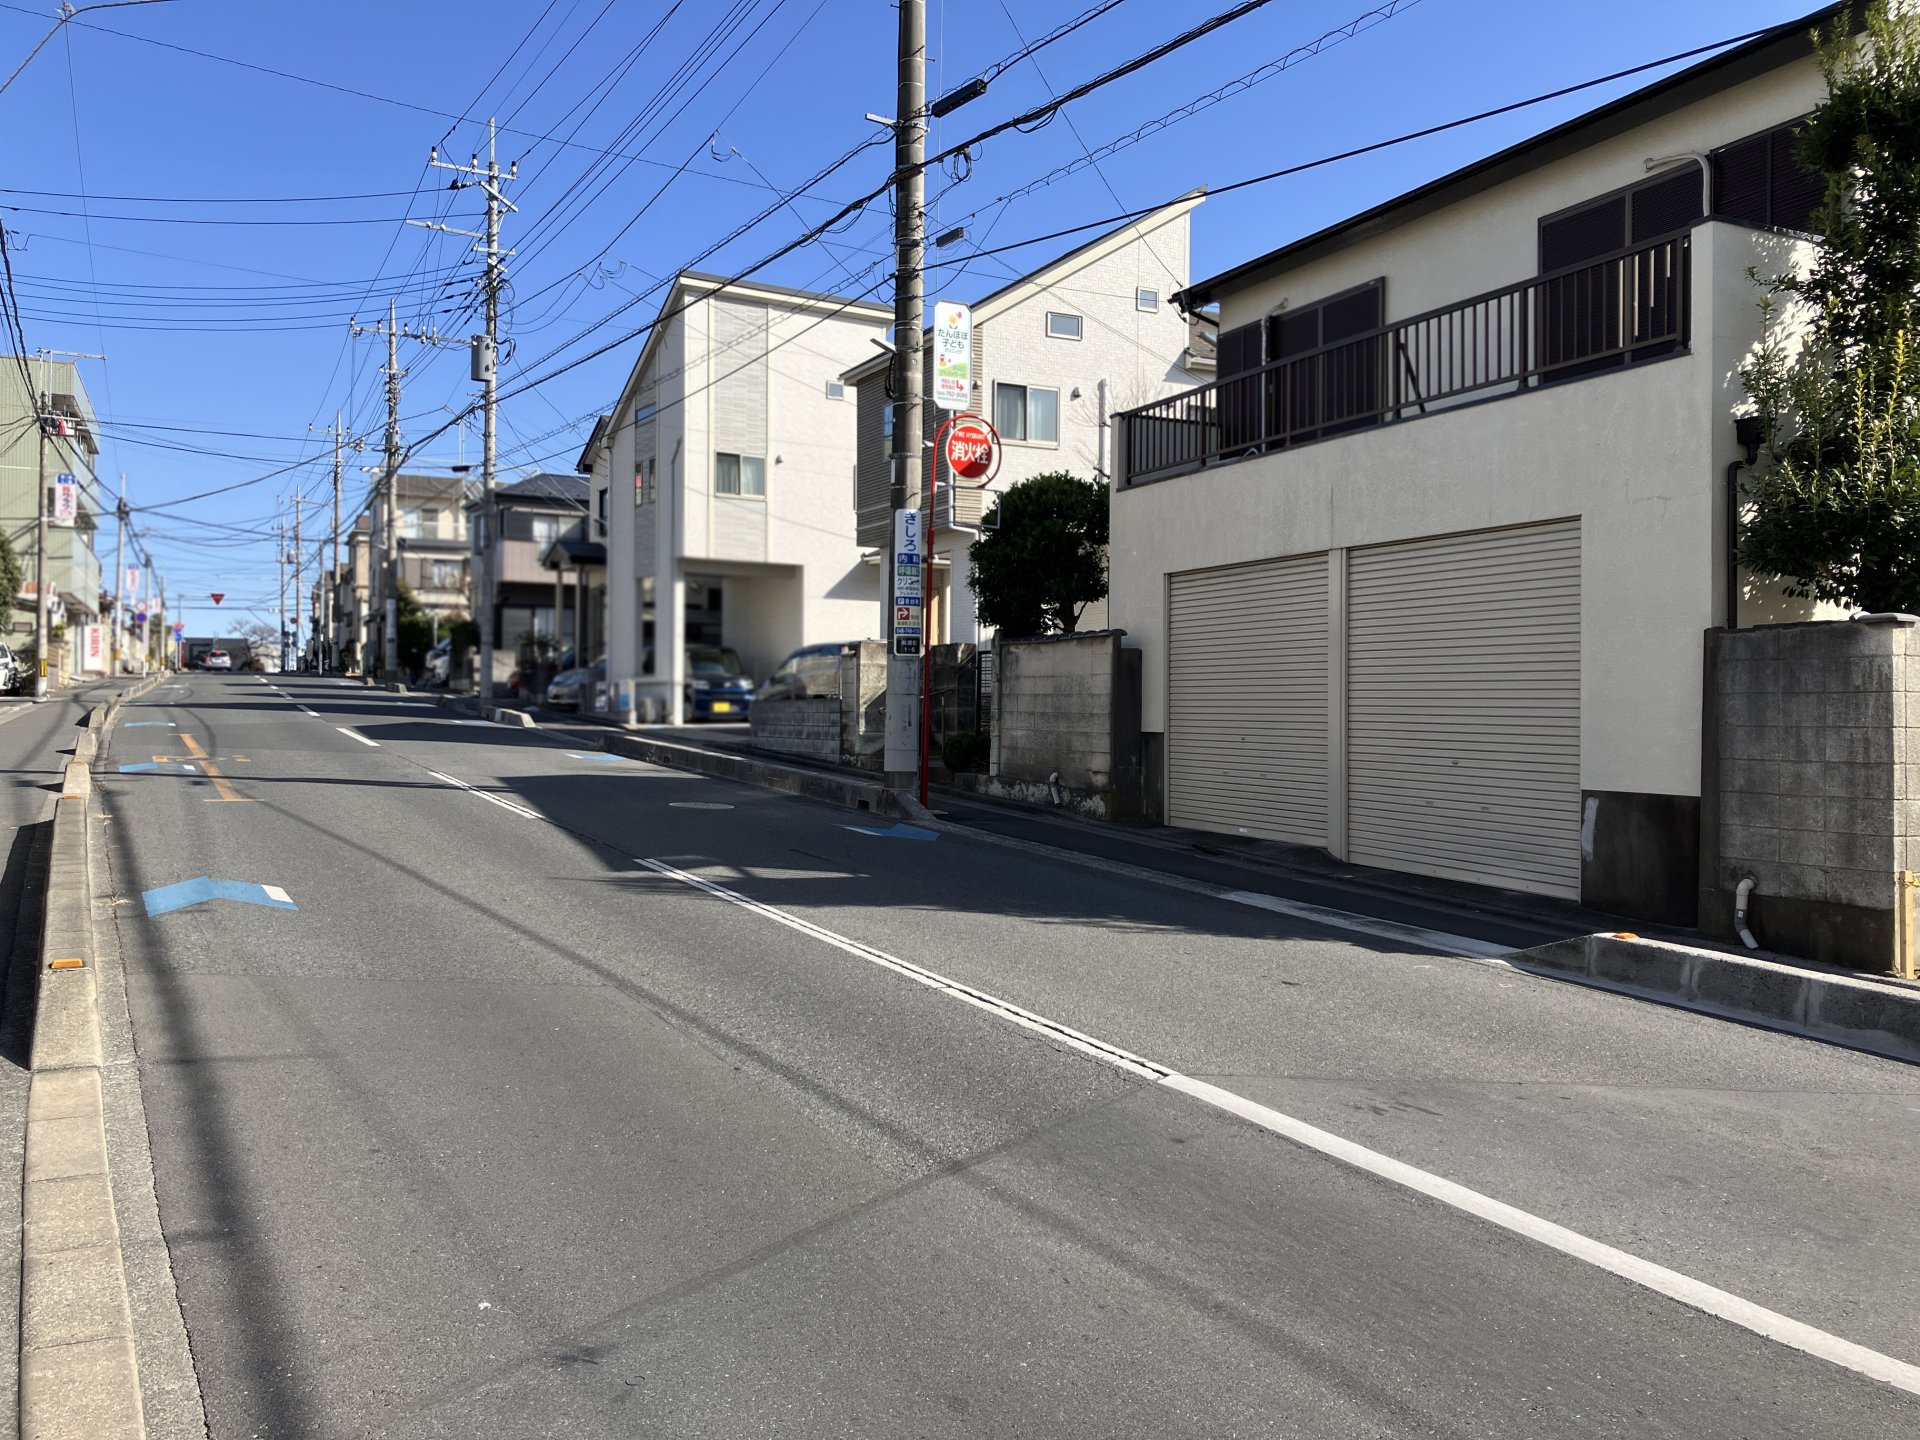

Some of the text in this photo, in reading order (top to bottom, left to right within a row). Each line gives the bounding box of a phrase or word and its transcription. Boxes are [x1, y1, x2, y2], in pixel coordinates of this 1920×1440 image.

[942, 338, 965, 349] 子ども
[965, 432, 985, 440] HYDRANT
[951, 440, 989, 464] 消火栓
[904, 512, 916, 552] きしろ
[898, 554, 919, 565] 内科
